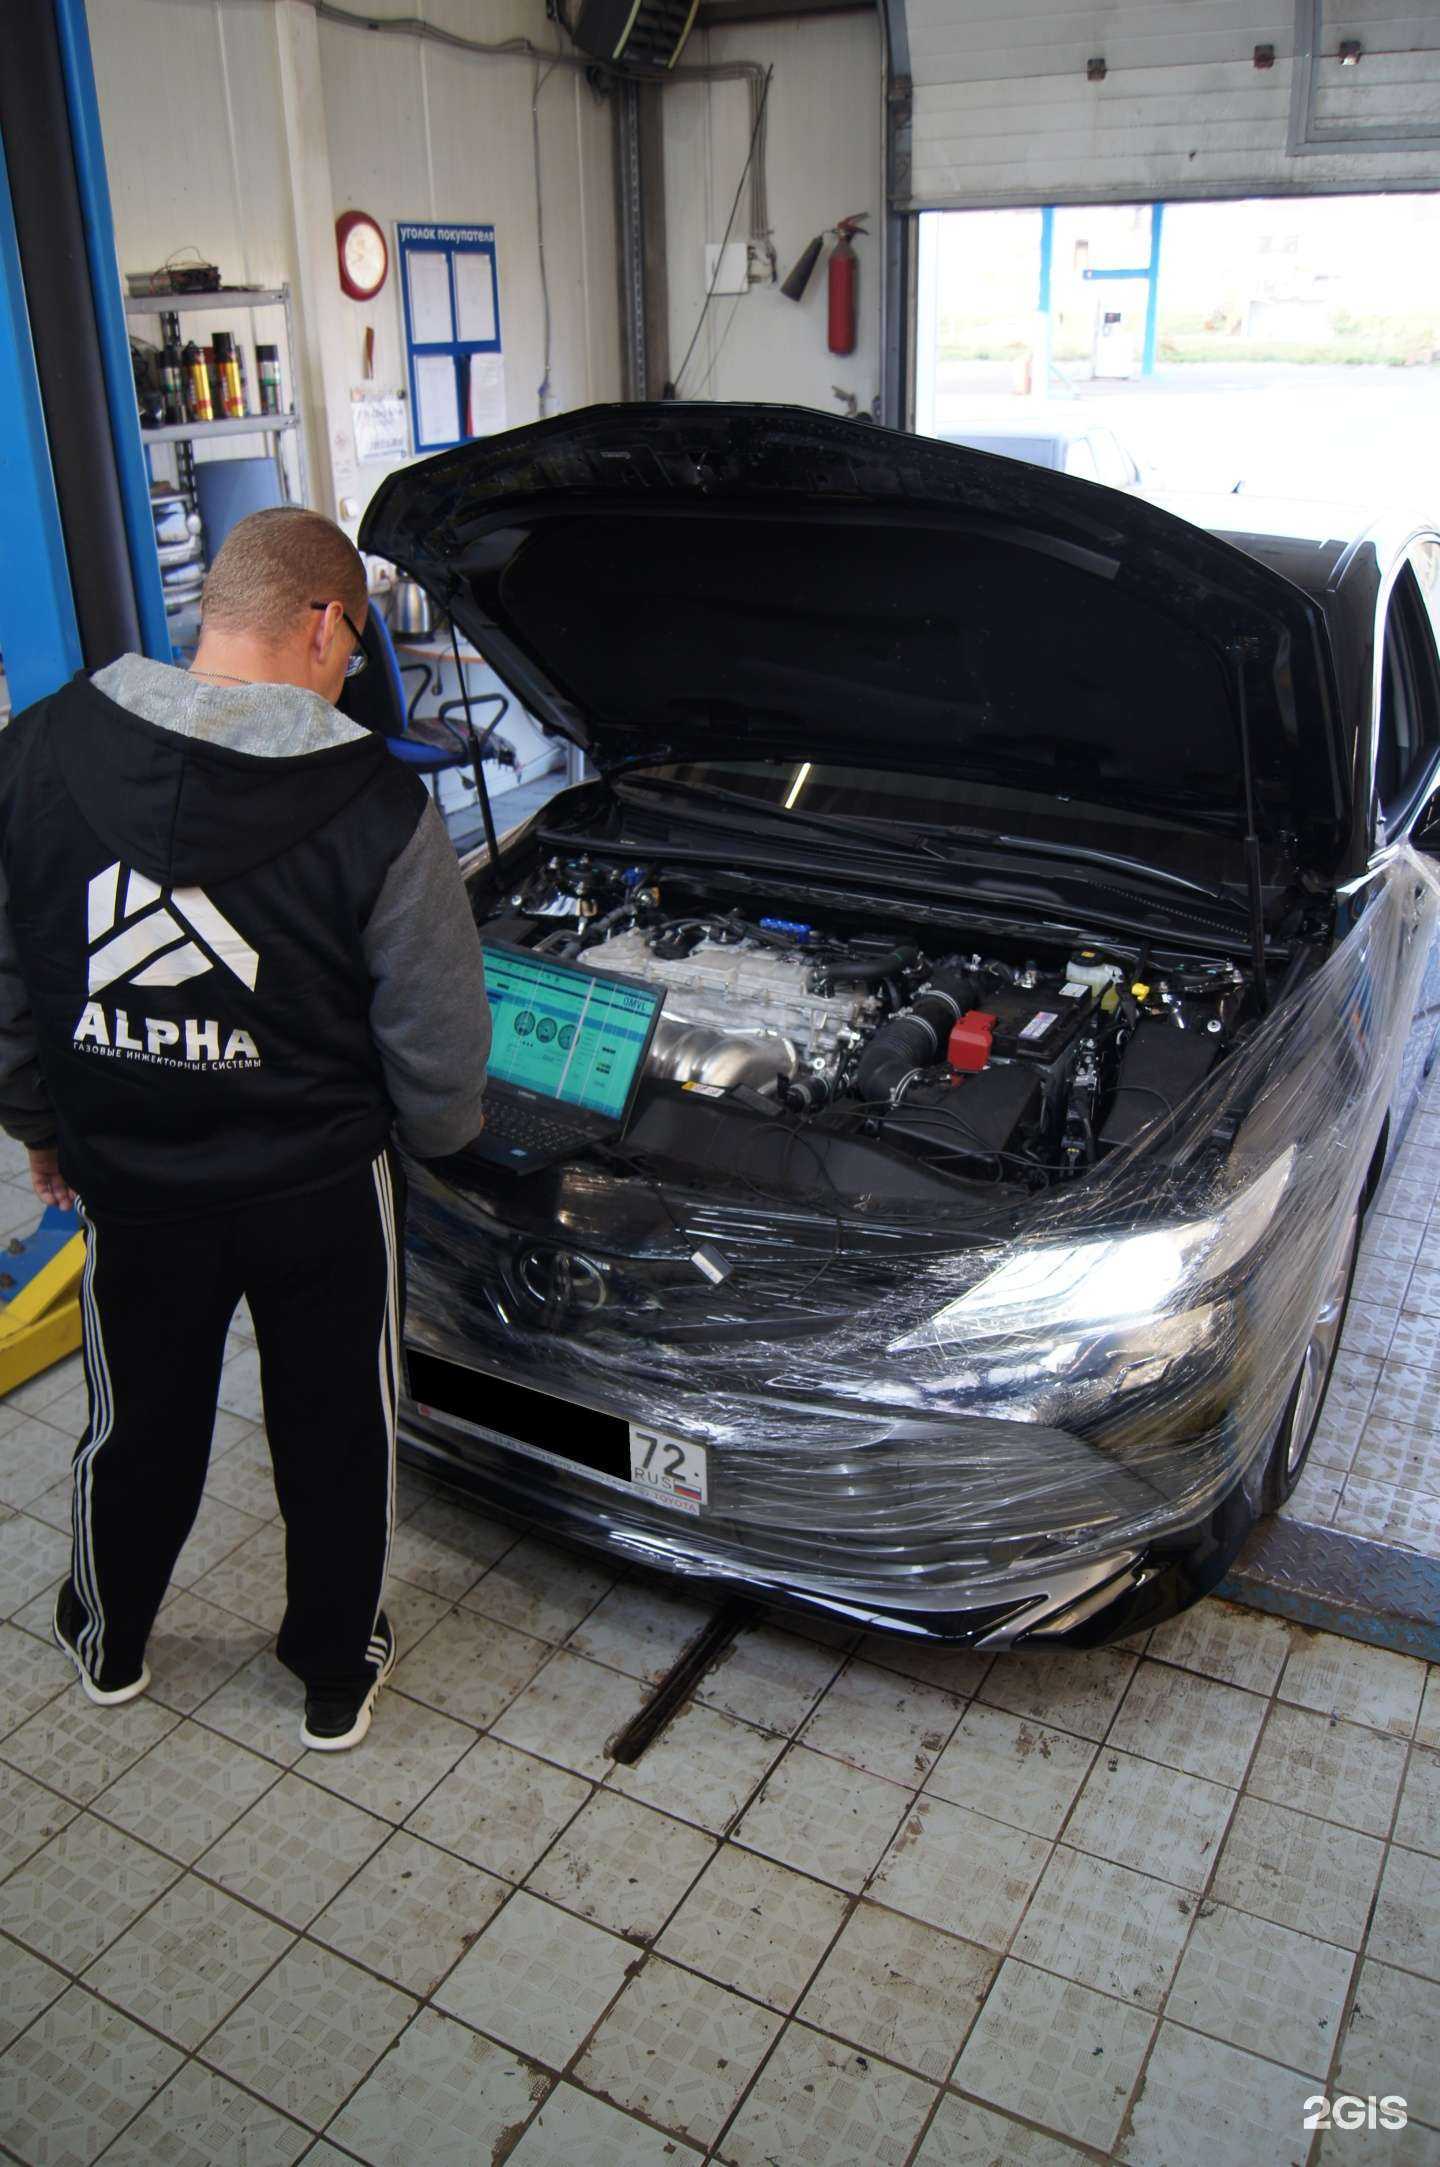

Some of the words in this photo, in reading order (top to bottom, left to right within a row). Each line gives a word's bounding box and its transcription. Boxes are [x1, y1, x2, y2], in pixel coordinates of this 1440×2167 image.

[73, 1001, 260, 1061] ALPHA
[73, 1042, 122, 1058] ГАЗОВЫЕ
[126, 1051, 207, 1071] ИНЖЕКТОРНЫЕ
[212, 1059, 262, 1071] СИСТЕМЫ
[636, 1432, 686, 1481] 72
[634, 1467, 672, 1490] RUS
[655, 1493, 697, 1513] TOYOTA
